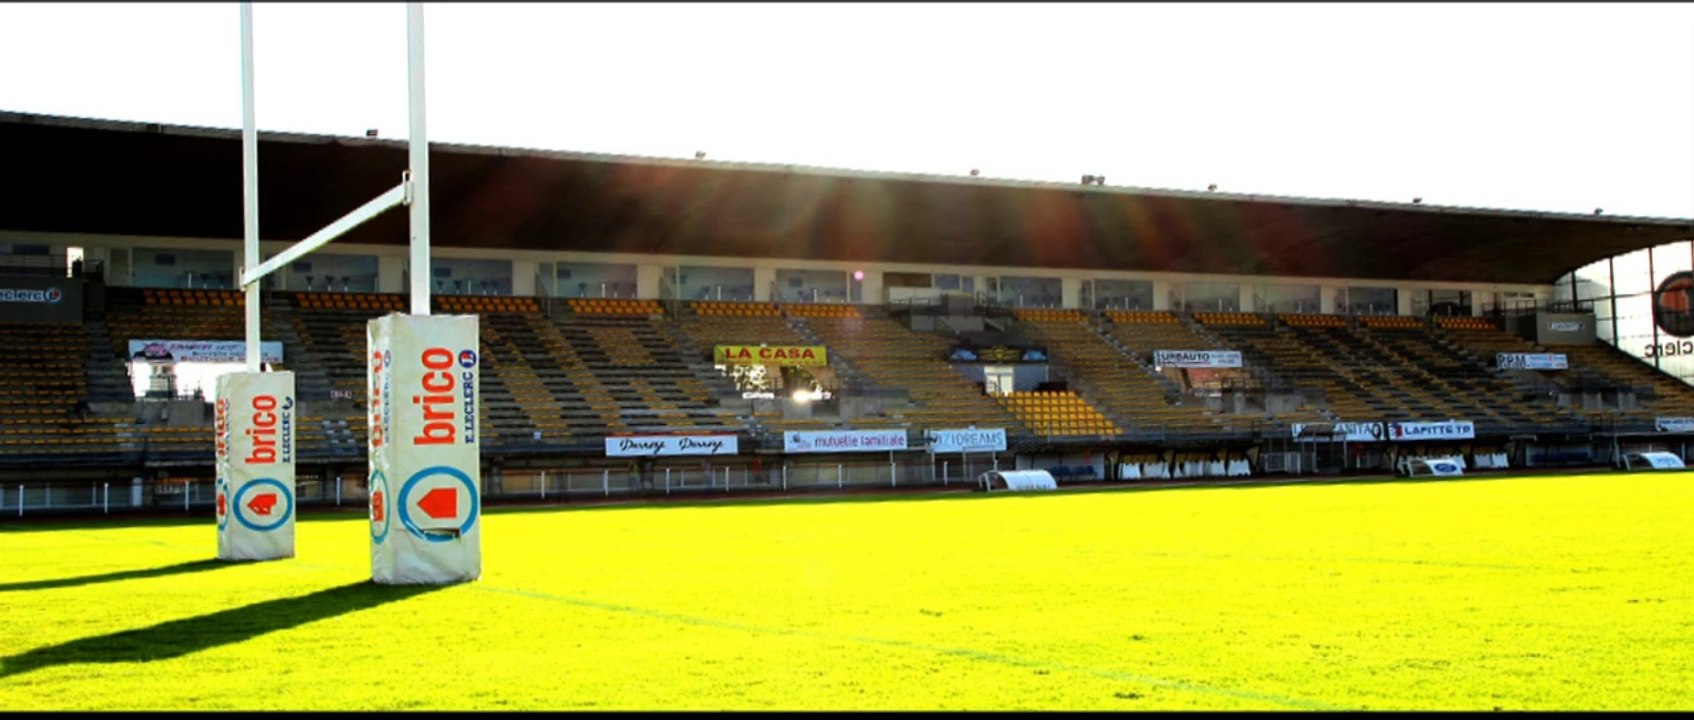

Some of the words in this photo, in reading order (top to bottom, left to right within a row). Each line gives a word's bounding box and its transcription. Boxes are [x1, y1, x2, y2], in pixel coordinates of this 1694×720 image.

[725, 348, 752, 359] LA
[758, 347, 816, 359] CASA
[413, 347, 456, 445] brico
[245, 394, 277, 464] brico
[1404, 425, 1453, 435] LAPITTE
[1456, 424, 1471, 434] TP
[815, 435, 859, 448] mutuelle
[861, 434, 905, 447] familiale
